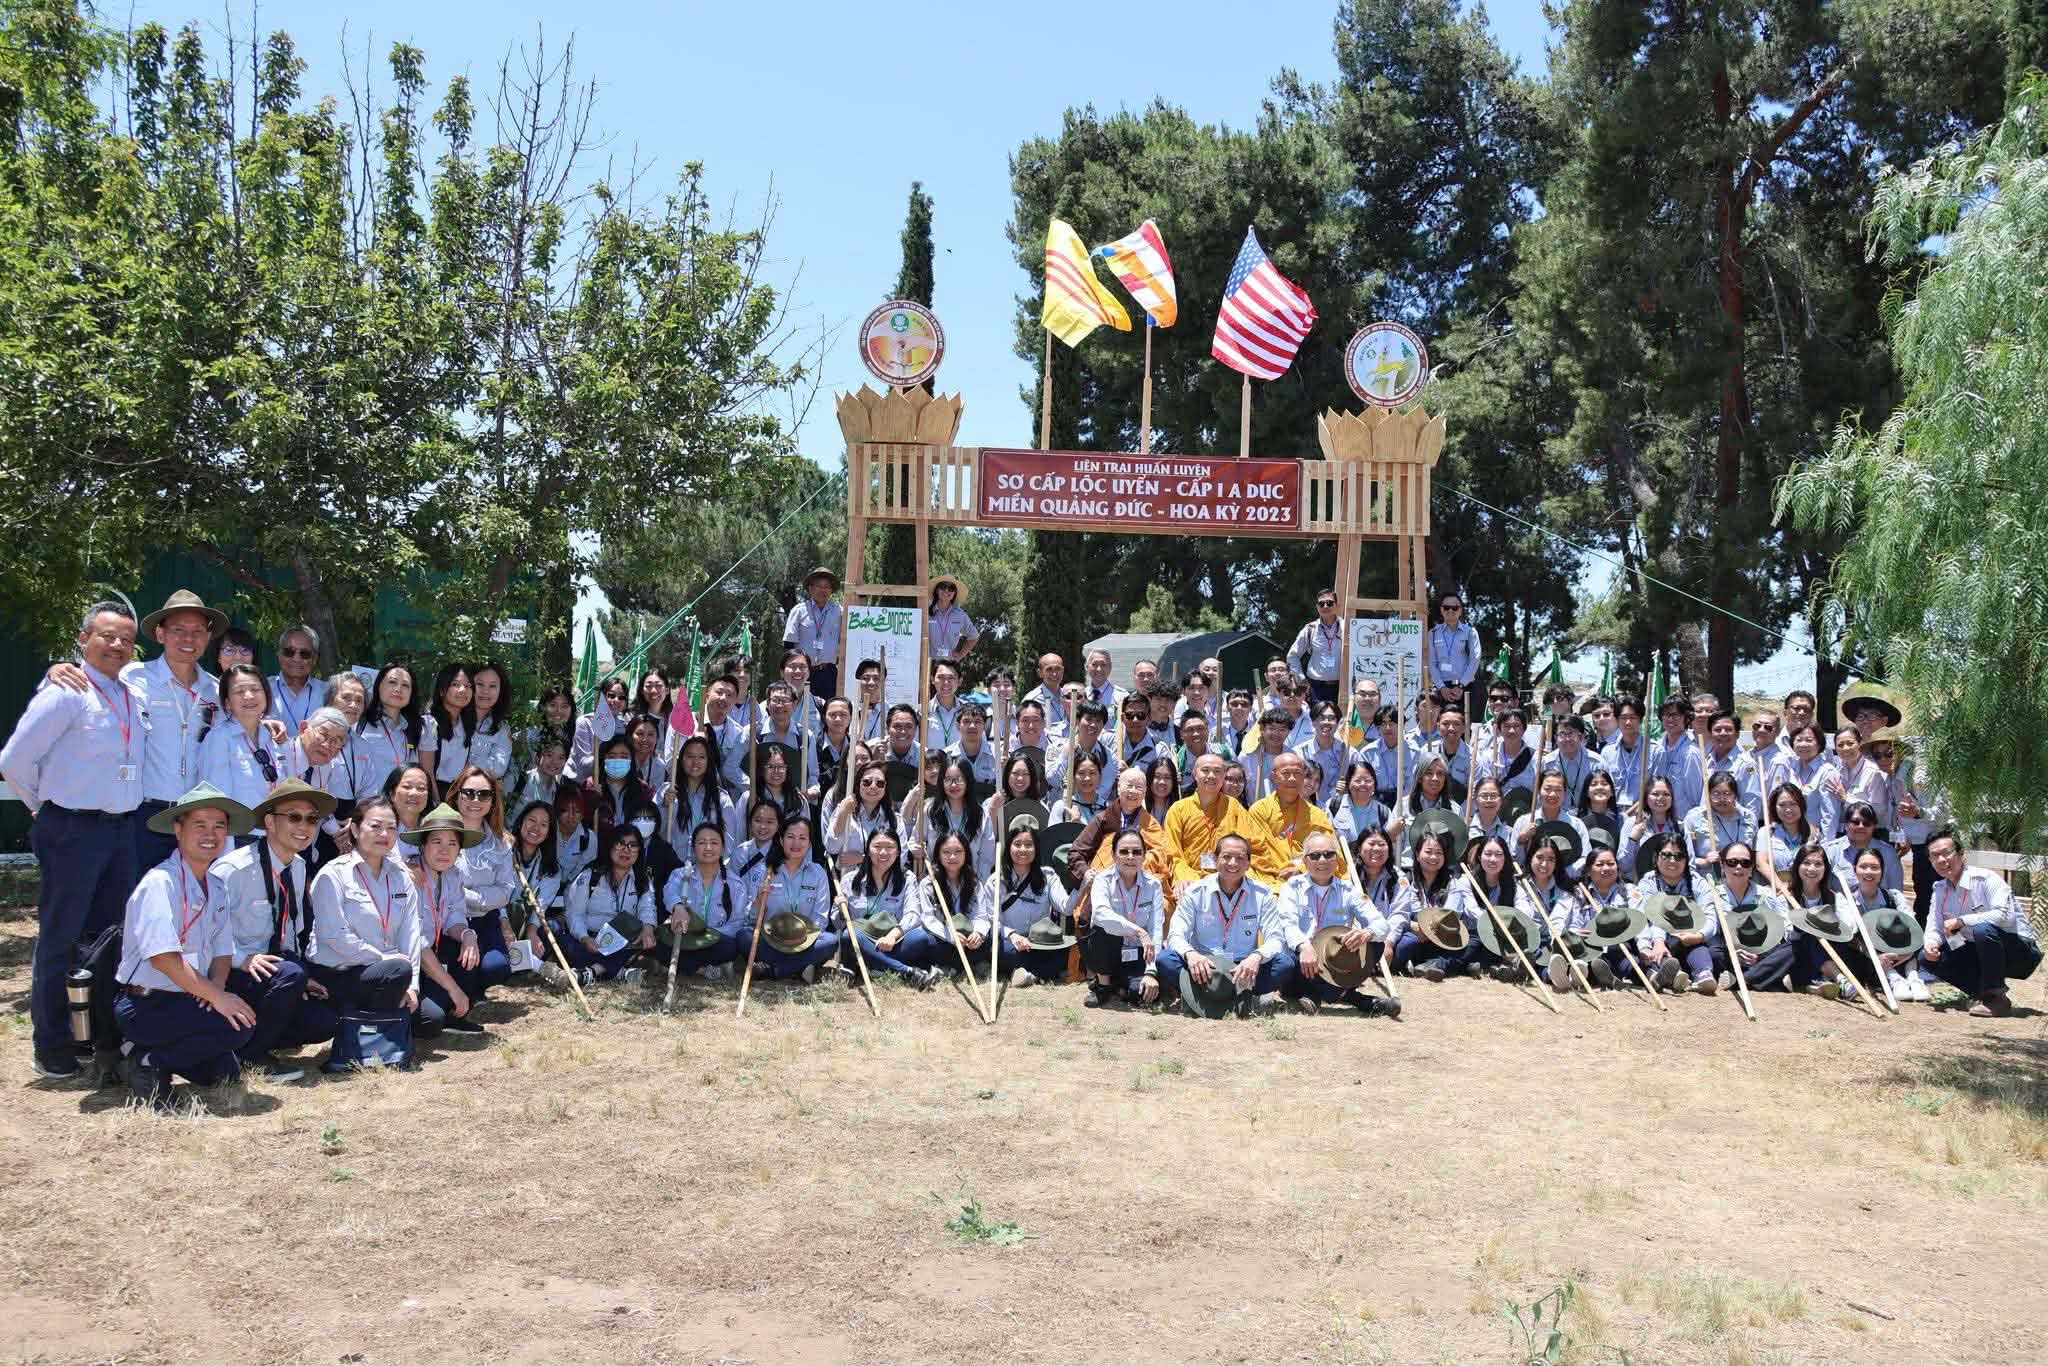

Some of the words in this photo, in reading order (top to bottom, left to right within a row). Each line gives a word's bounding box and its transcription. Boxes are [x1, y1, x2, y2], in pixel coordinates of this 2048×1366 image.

[1074, 459, 1100, 472] LIÊN
[998, 473, 1024, 490] SƠ
[1029, 471, 1066, 492] CẤP
[1071, 475, 1107, 496] LỘC
[1176, 477, 1213, 497] CẤP
[1228, 482, 1242, 499] A
[1246, 483, 1284, 502] DỤC
[1040, 495, 1109, 517] QUẢNG
[1115, 498, 1153, 518] ĐỨC
[1169, 503, 1211, 520] HOA
[1215, 502, 1240, 521] KỲ
[1245, 506, 1292, 522] 2023
[1391, 623, 1419, 635] KNOTS
